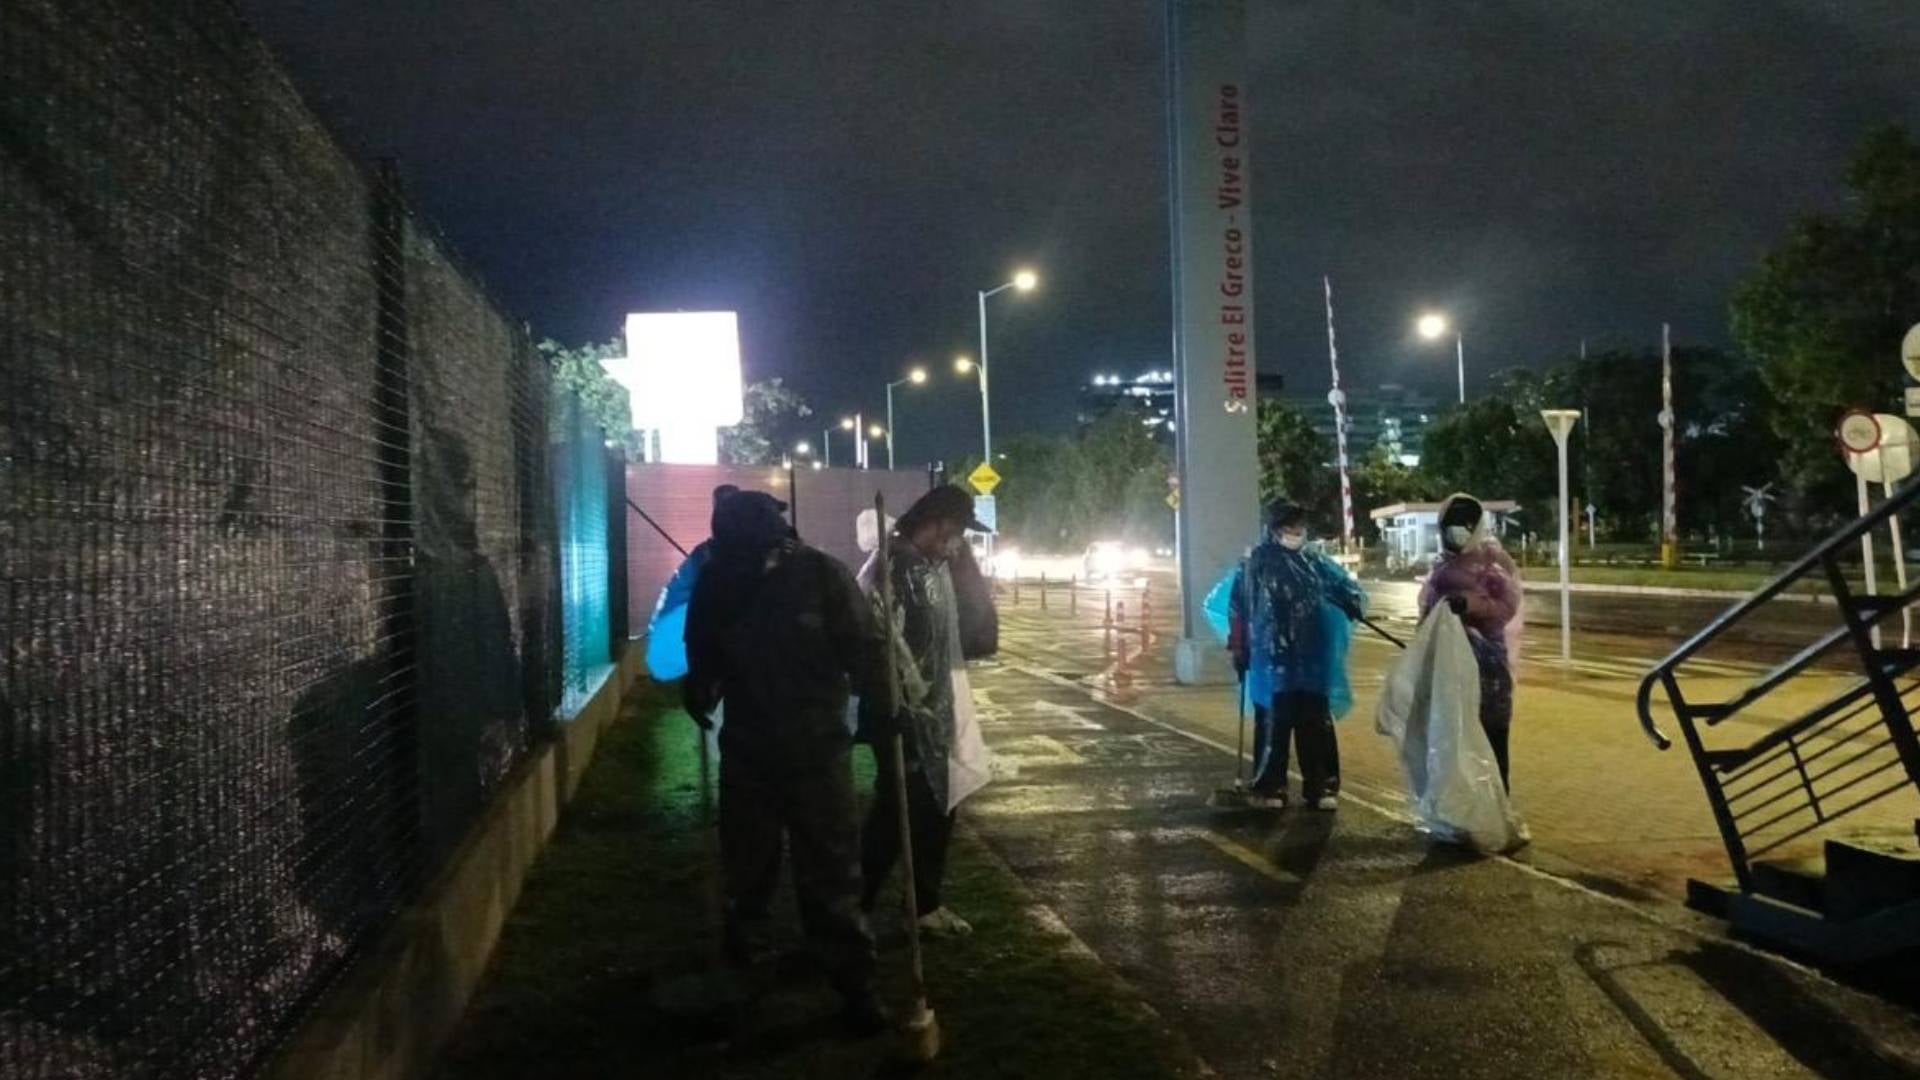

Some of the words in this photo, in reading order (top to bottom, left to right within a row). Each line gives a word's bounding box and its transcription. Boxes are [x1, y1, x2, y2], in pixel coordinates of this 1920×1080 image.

[1216, 84, 1239, 147] Claro
[1218, 156, 1241, 209] Vive
[1221, 228, 1243, 297] Greco
[1222, 306, 1244, 324] El
[1224, 332, 1247, 413] Salitre
